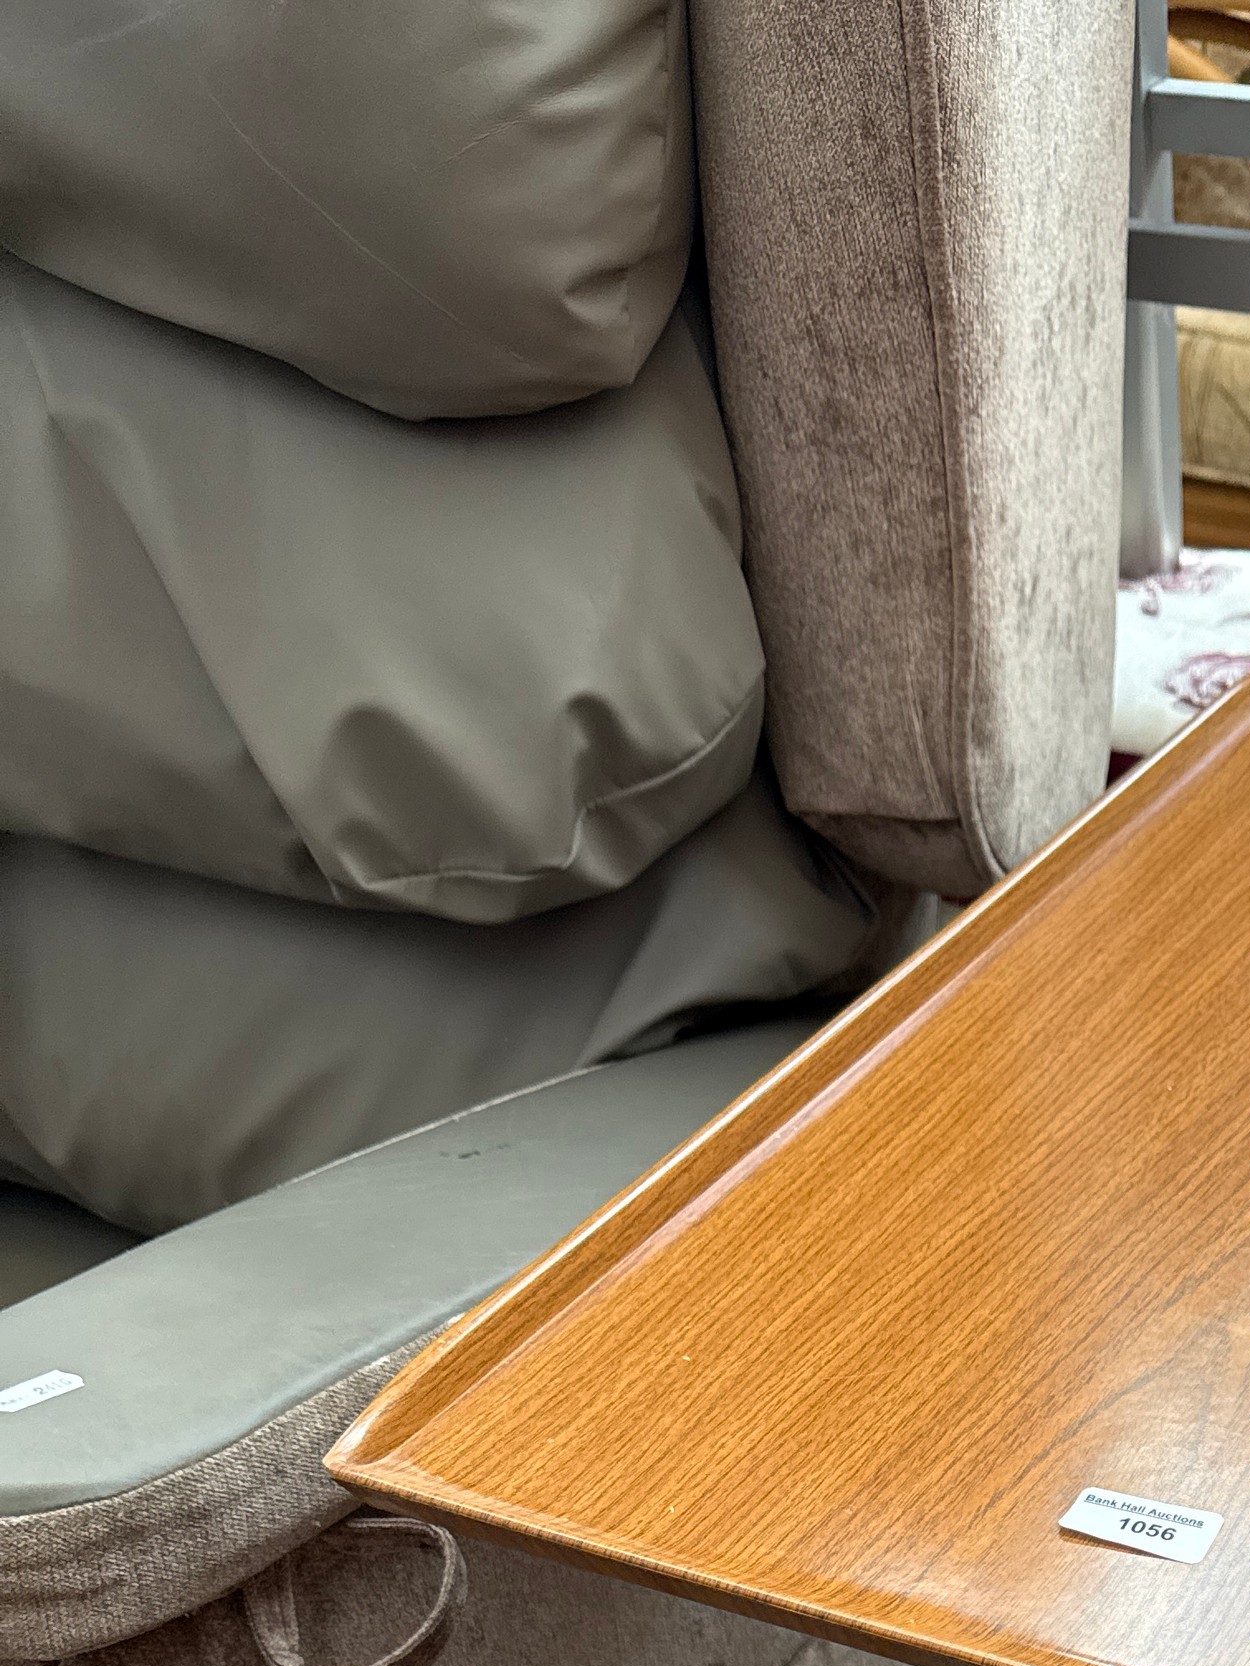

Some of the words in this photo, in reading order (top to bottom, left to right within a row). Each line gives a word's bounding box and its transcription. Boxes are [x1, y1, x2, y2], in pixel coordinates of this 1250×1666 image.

[1085, 1494, 1118, 1508] Bank
[1120, 1501, 1146, 1514] Hall
[1148, 1508, 1204, 1527] Auctions
[1119, 1517, 1177, 1541] 1056
